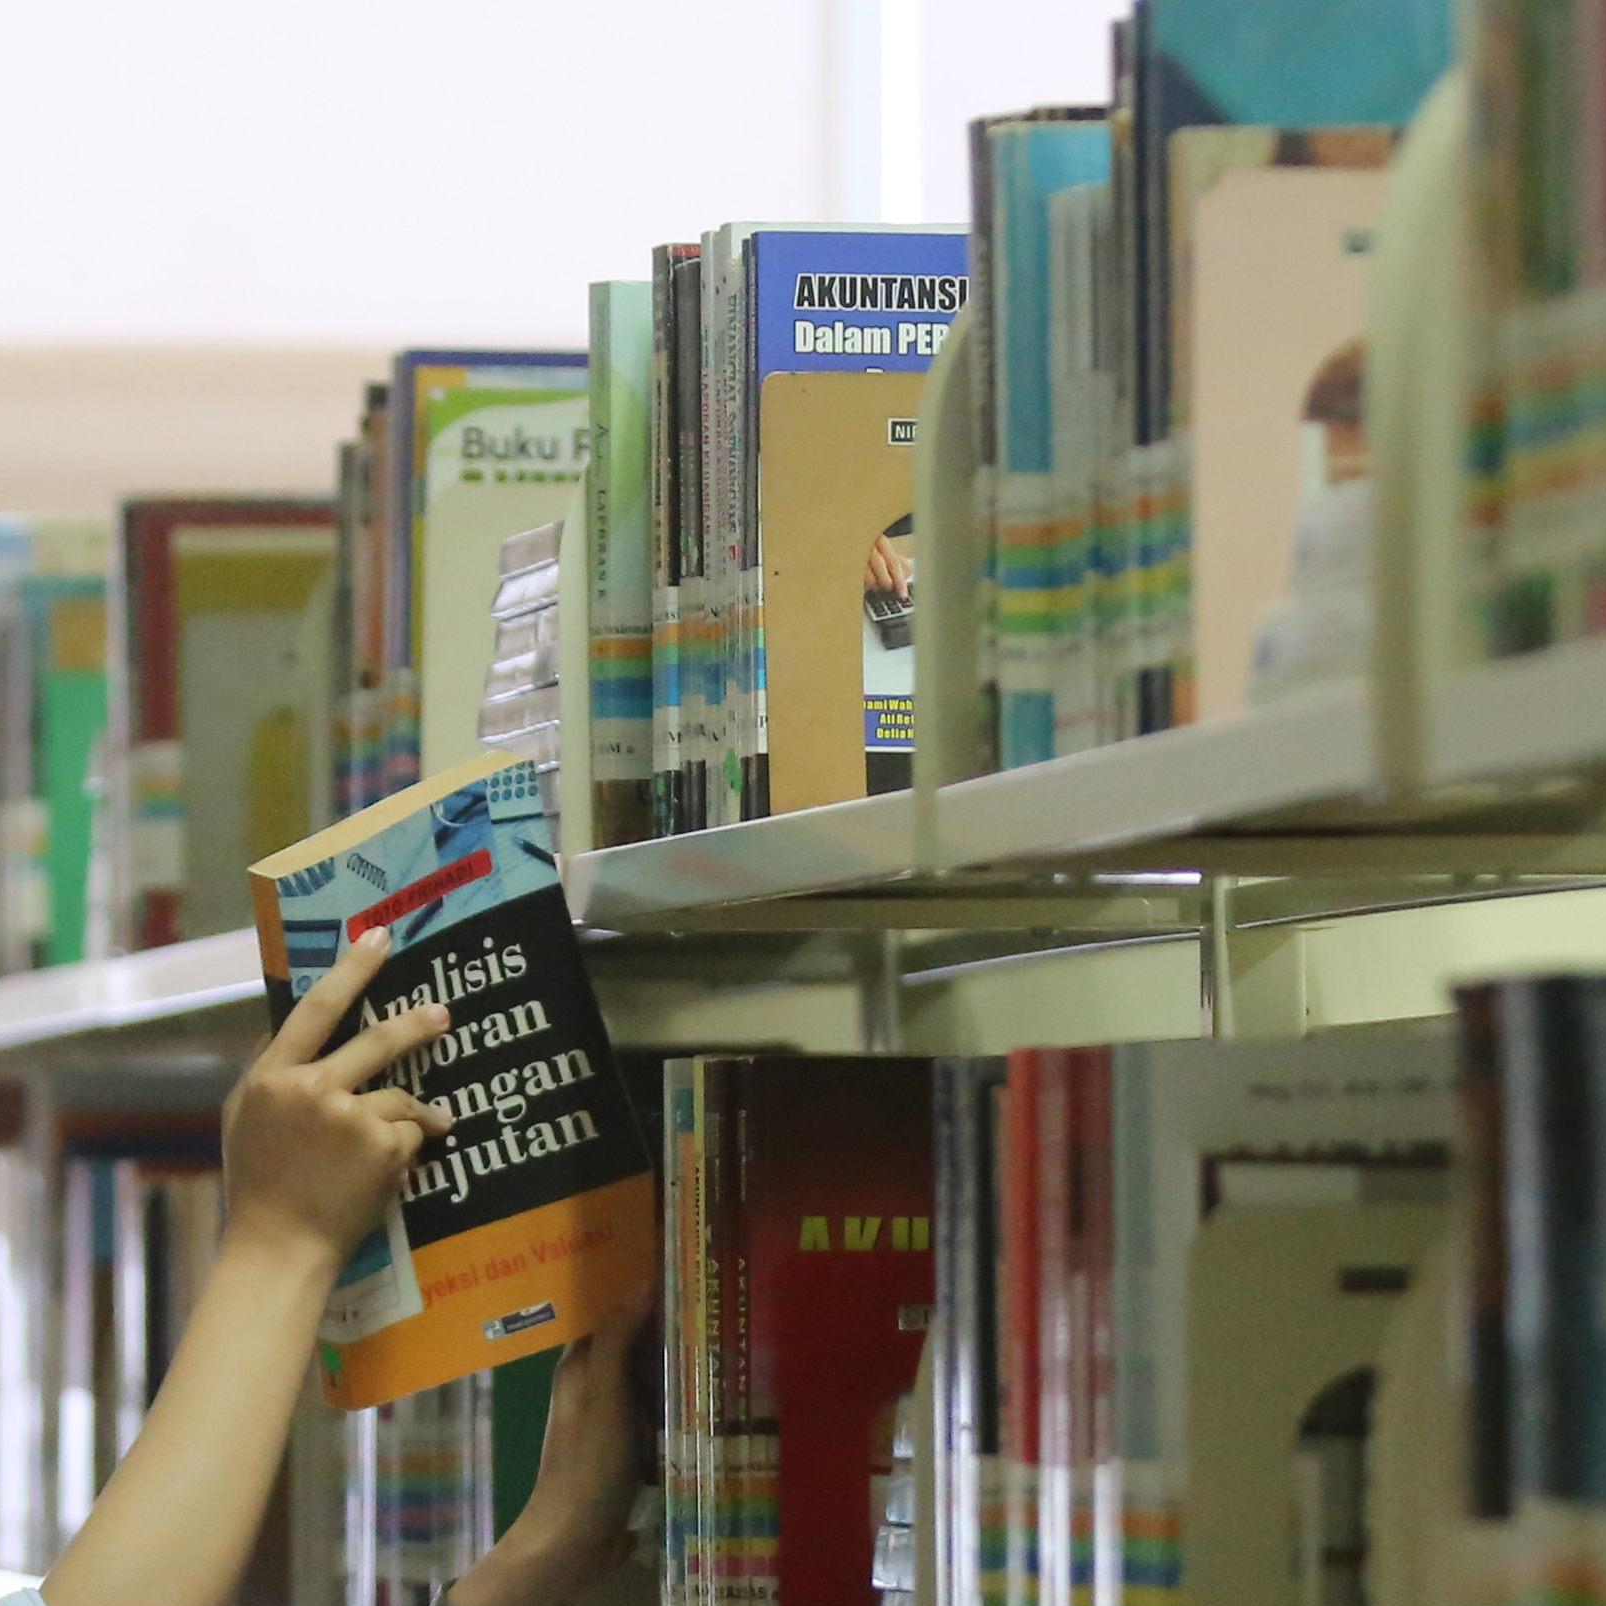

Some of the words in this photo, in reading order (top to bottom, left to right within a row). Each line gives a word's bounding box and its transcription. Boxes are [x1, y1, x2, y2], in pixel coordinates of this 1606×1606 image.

[794, 272, 970, 312] AKUNTANSI
[795, 320, 892, 354] Dalam
[461, 424, 559, 461] Buku
[863, 699, 888, 710] ami
[364, 901, 402, 926] TOTO
[407, 861, 474, 902] PRIHADI
[359, 936, 528, 1032] Analisis
[359, 999, 552, 1097] aporan
[484, 1252, 528, 1282] dan
